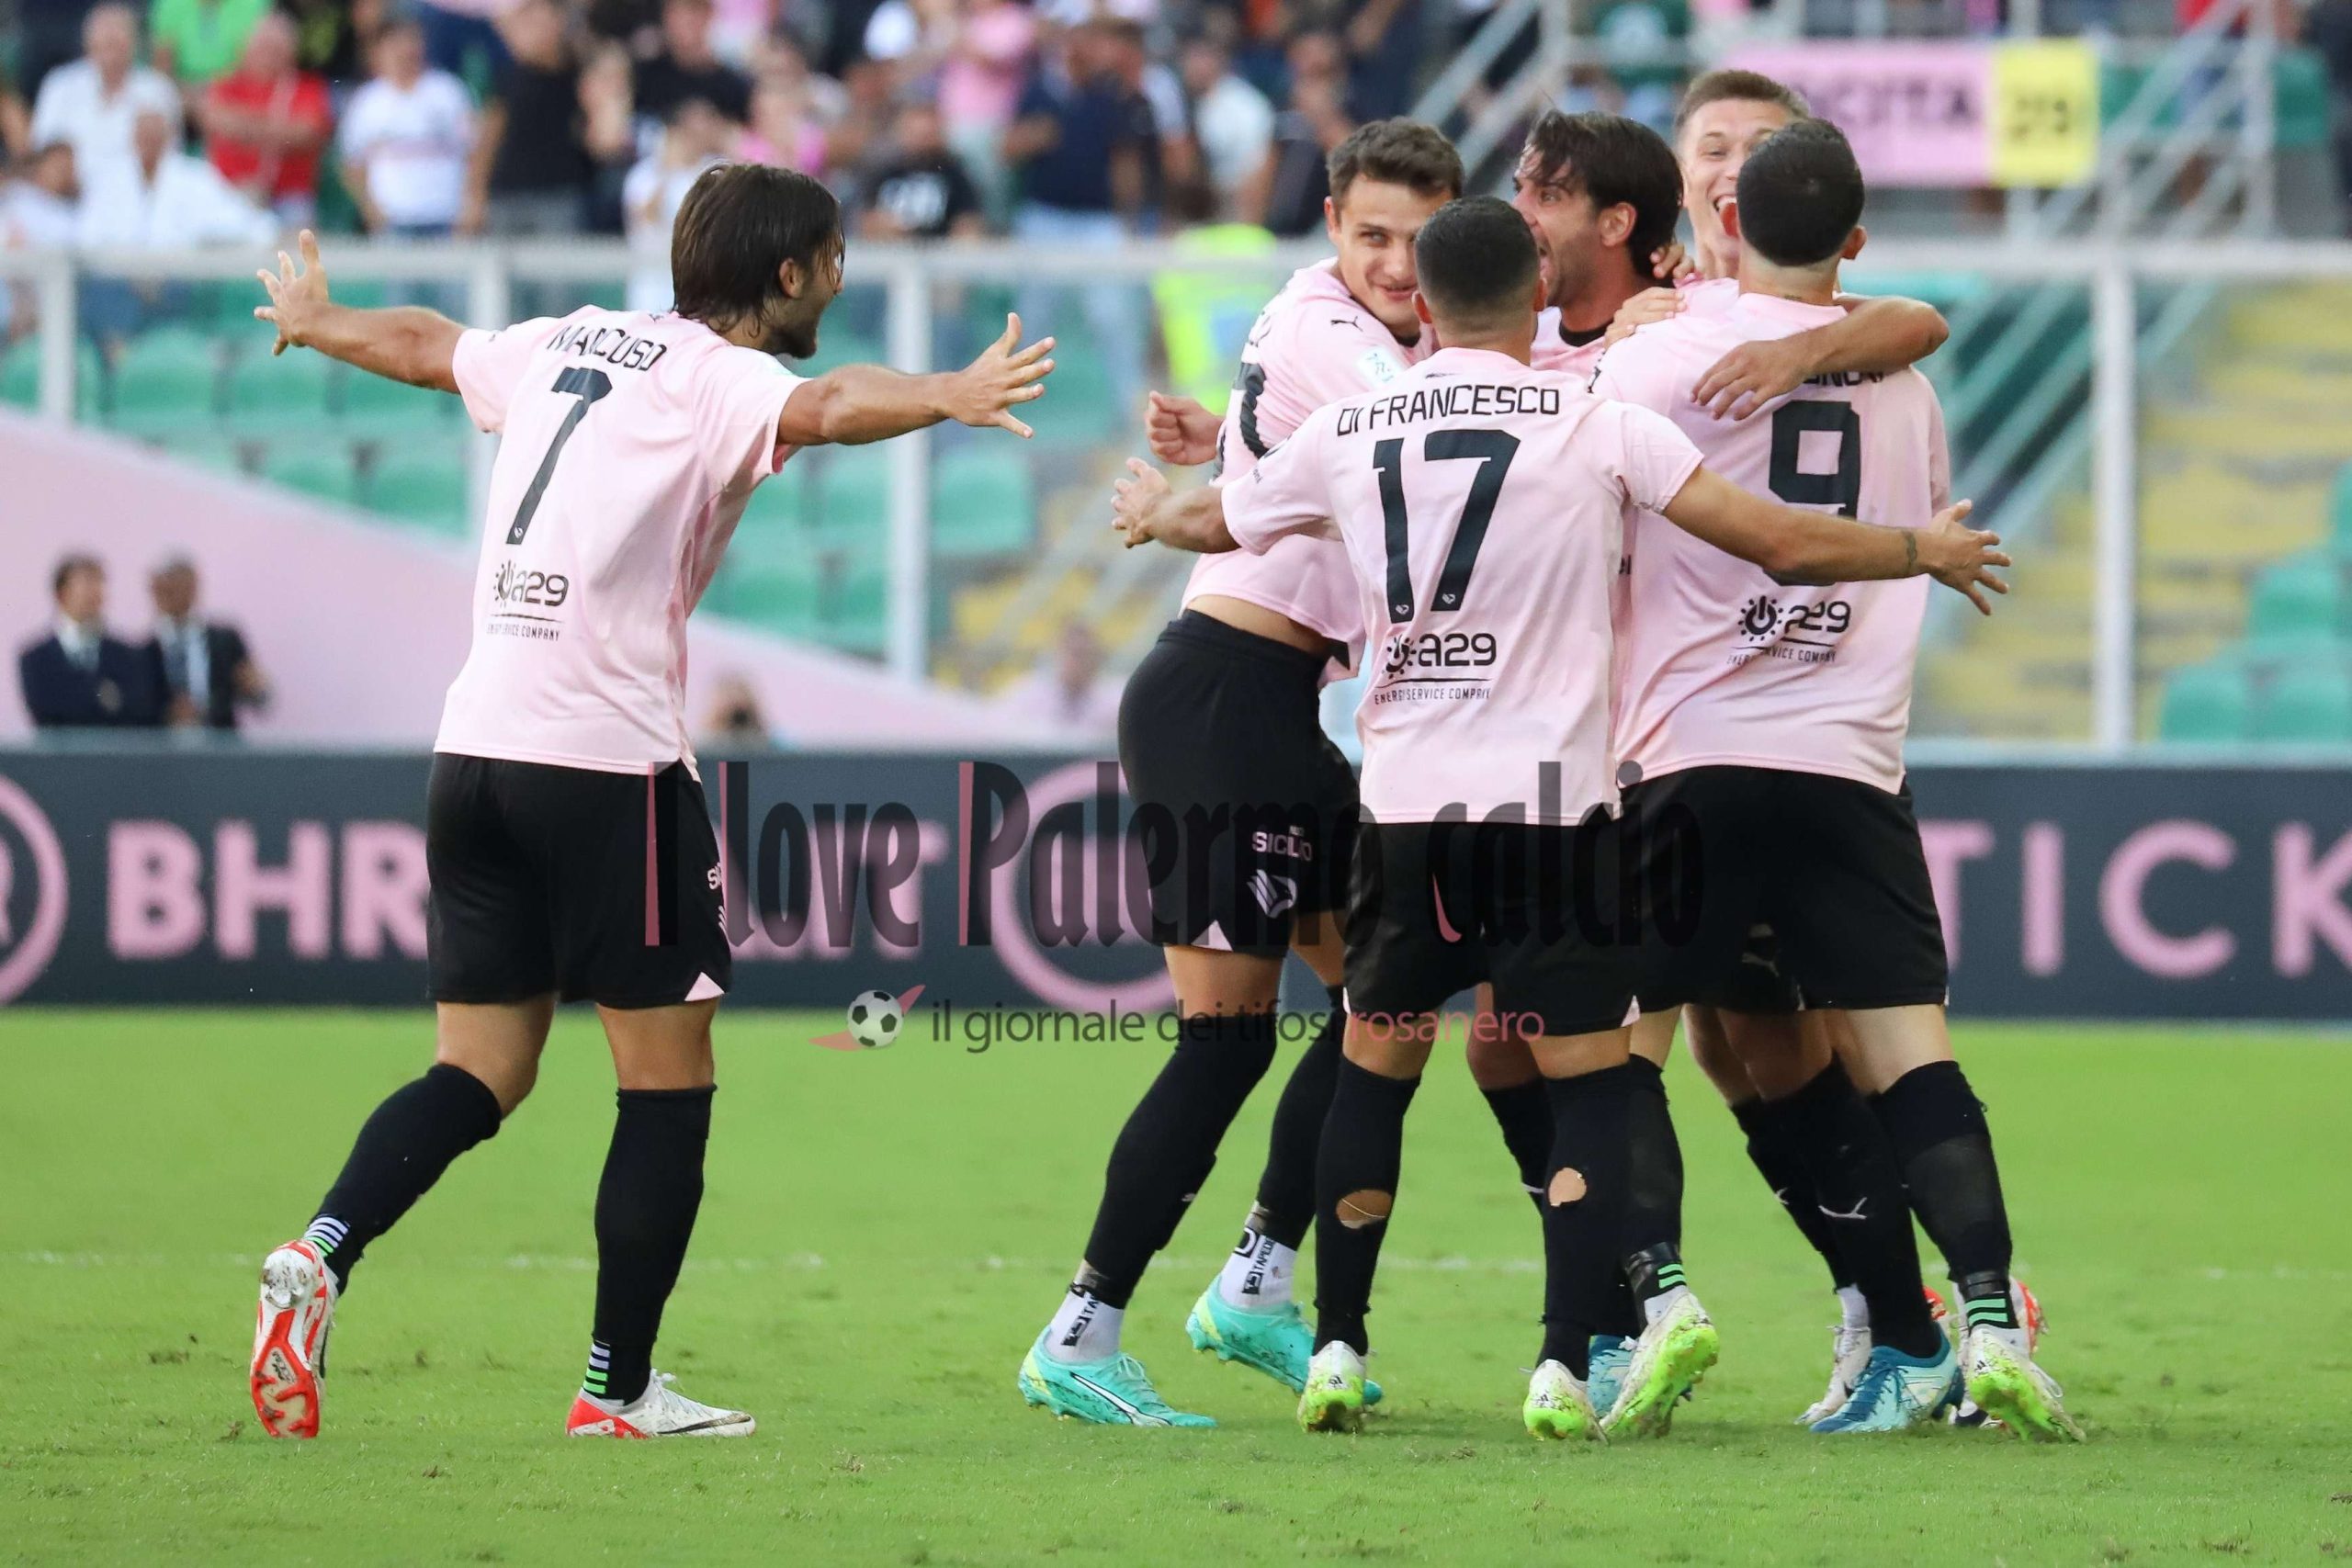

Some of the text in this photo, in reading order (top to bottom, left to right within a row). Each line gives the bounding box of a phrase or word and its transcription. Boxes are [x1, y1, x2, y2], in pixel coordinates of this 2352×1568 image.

[1337, 385, 1559, 436] DI FRANCESCO
[506, 367, 613, 545] 7
[1769, 399, 1861, 523] 9
[1373, 429, 1521, 624] 17
[1407, 687, 1445, 700] SERVICE
[1419, 633, 1497, 667] a29
